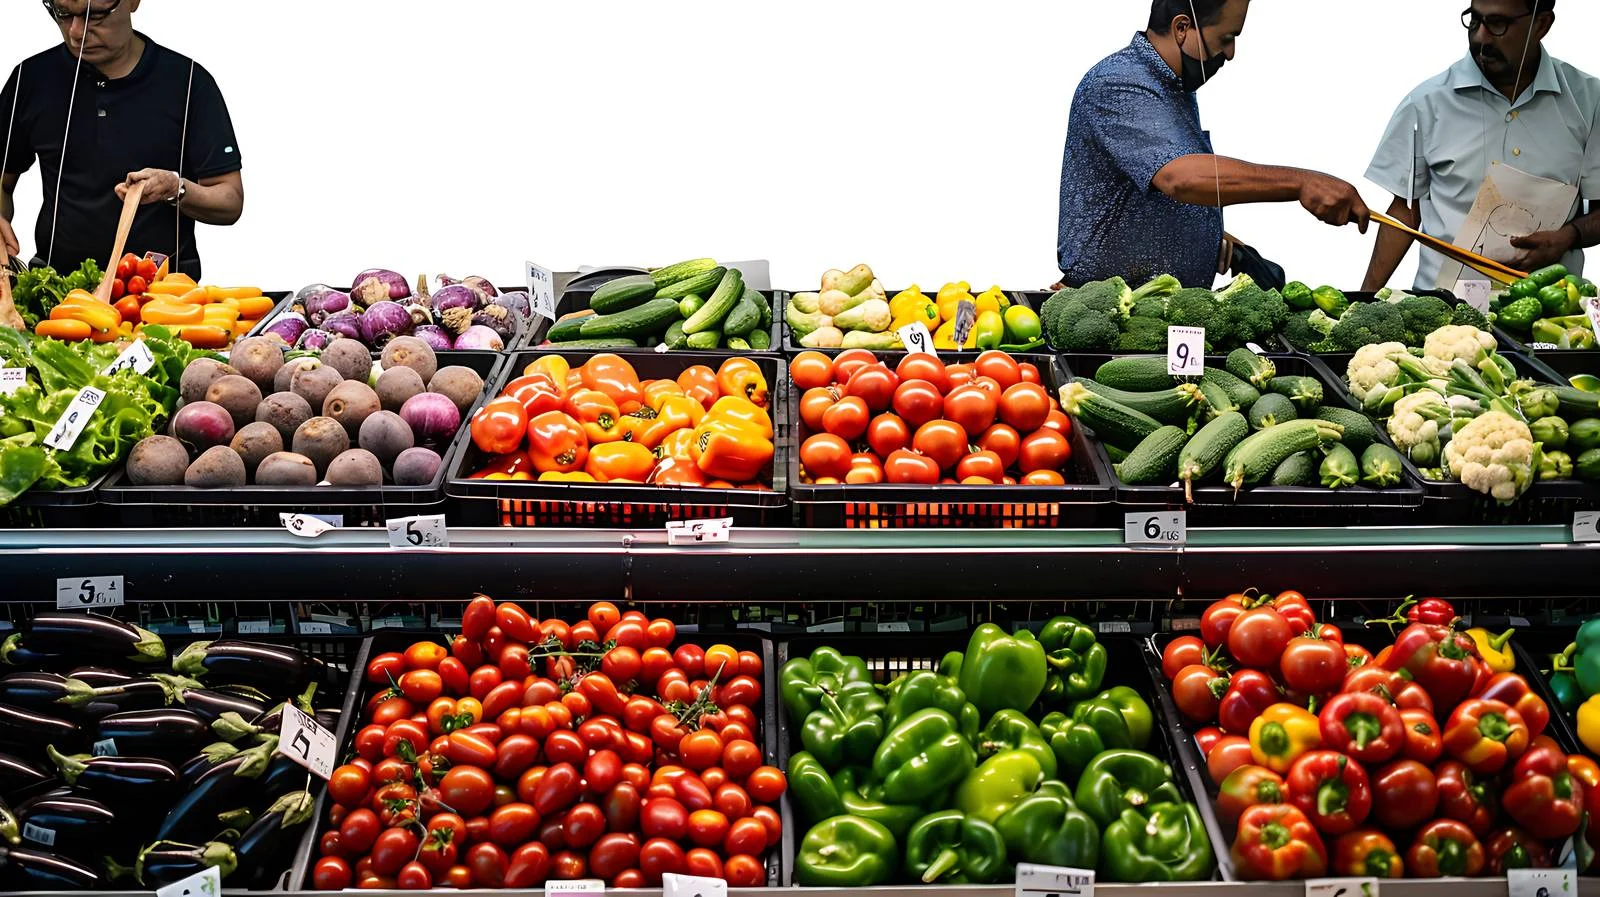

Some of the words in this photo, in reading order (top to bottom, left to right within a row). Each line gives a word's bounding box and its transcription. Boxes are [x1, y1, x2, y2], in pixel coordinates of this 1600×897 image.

[1175, 343, 1189, 369] 9
[406, 520, 423, 546] 5
[1144, 516, 1161, 539] 6
